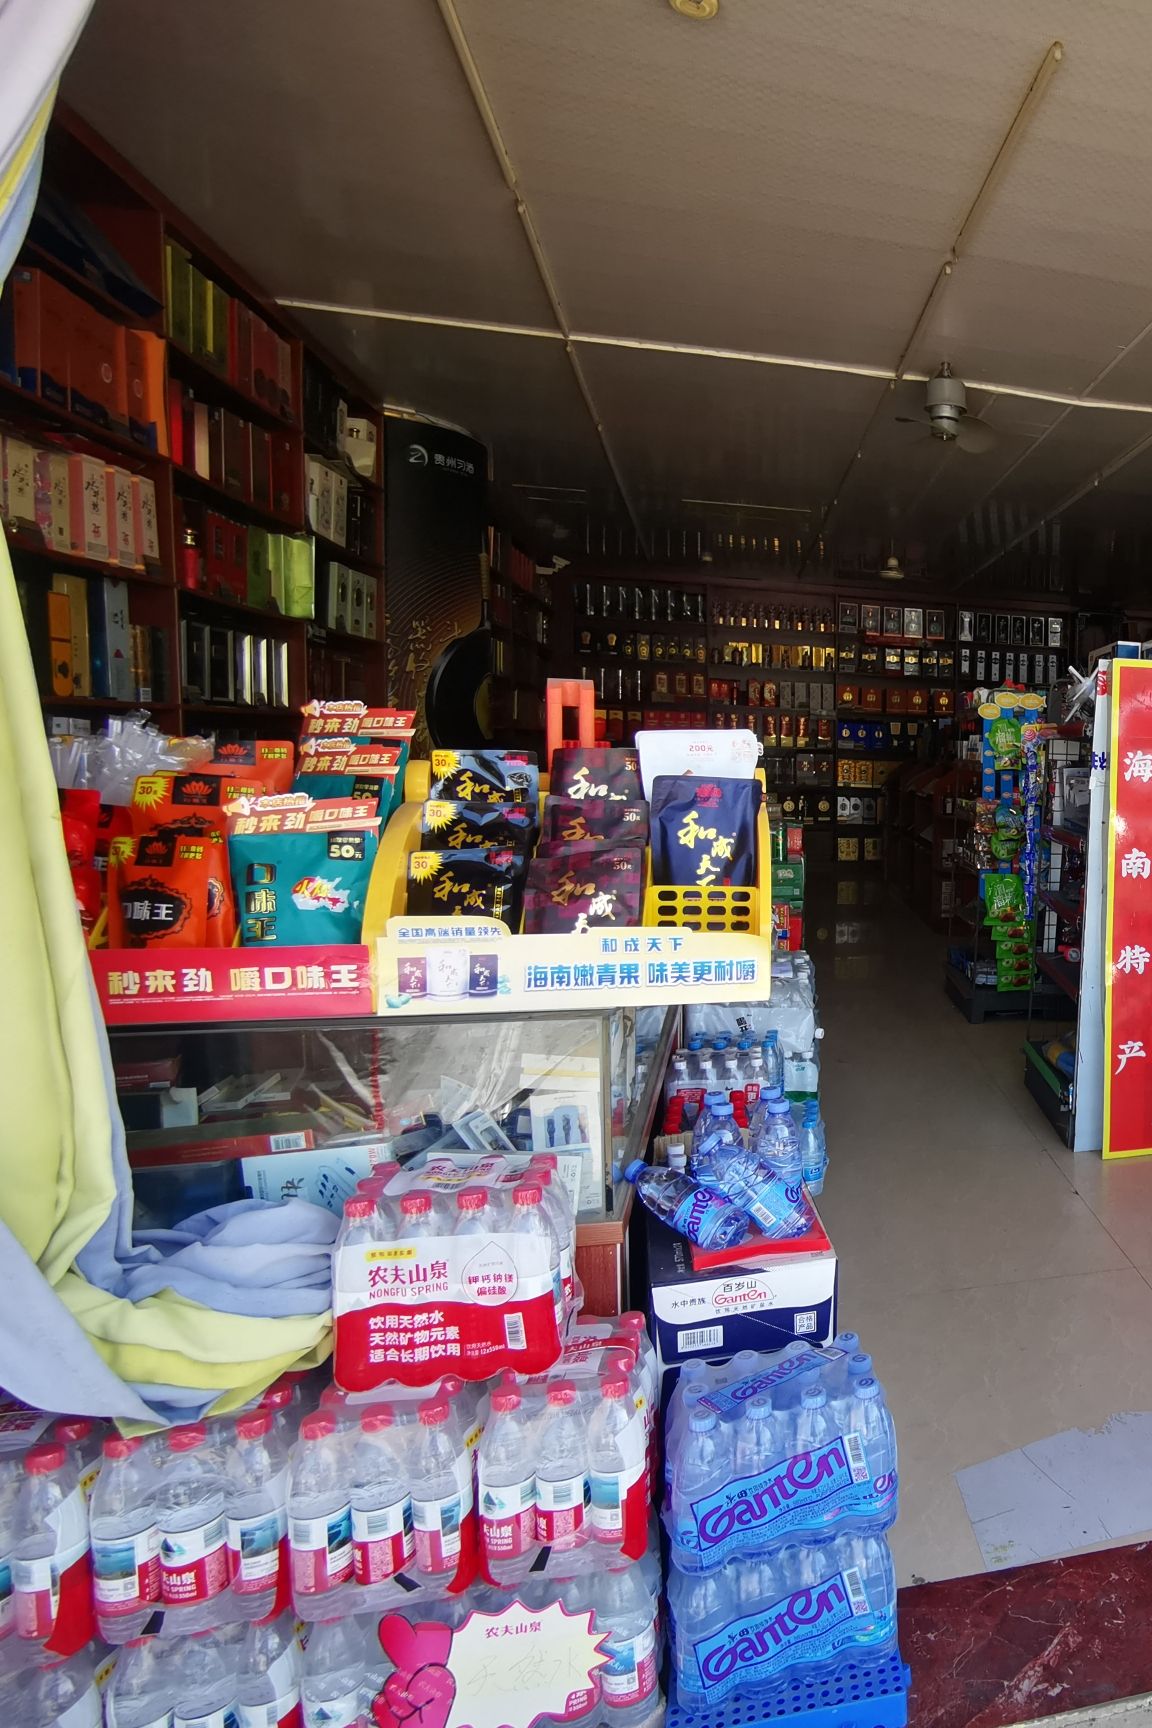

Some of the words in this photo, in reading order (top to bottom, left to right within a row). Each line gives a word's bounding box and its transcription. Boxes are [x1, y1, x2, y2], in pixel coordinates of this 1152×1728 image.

[308, 718, 360, 734] 秒来劲
[301, 755, 348, 773] 秒来劲
[234, 812, 306, 834] 秒来劲
[246, 864, 277, 942] 口味王
[397, 926, 502, 938] 全国高端销量领先
[601, 936, 684, 953] 和成天下
[107, 967, 213, 995] 秒来劲
[230, 964, 360, 991] 嚼口味王
[526, 964, 640, 989] 海南嫩青果
[647, 959, 757, 984] 味美更耐嚼
[368, 1260, 448, 1288] 农夫山泉
[369, 1287, 407, 1300] NONGFU
[411, 1281, 449, 1297] SPRING
[477, 1286, 507, 1297] 偏硅酸
[723, 1280, 757, 1293] 百岁山
[671, 1297, 707, 1309] 水中贵族
[369, 1310, 445, 1329] 饮用天然水
[797, 1323, 814, 1331] 产品
[798, 1315, 813, 1323] 合格
[369, 1326, 461, 1347] 天然矿物元素
[369, 1343, 462, 1364] 适合长期饮用
[484, 1622, 543, 1638] 农夫山泉
